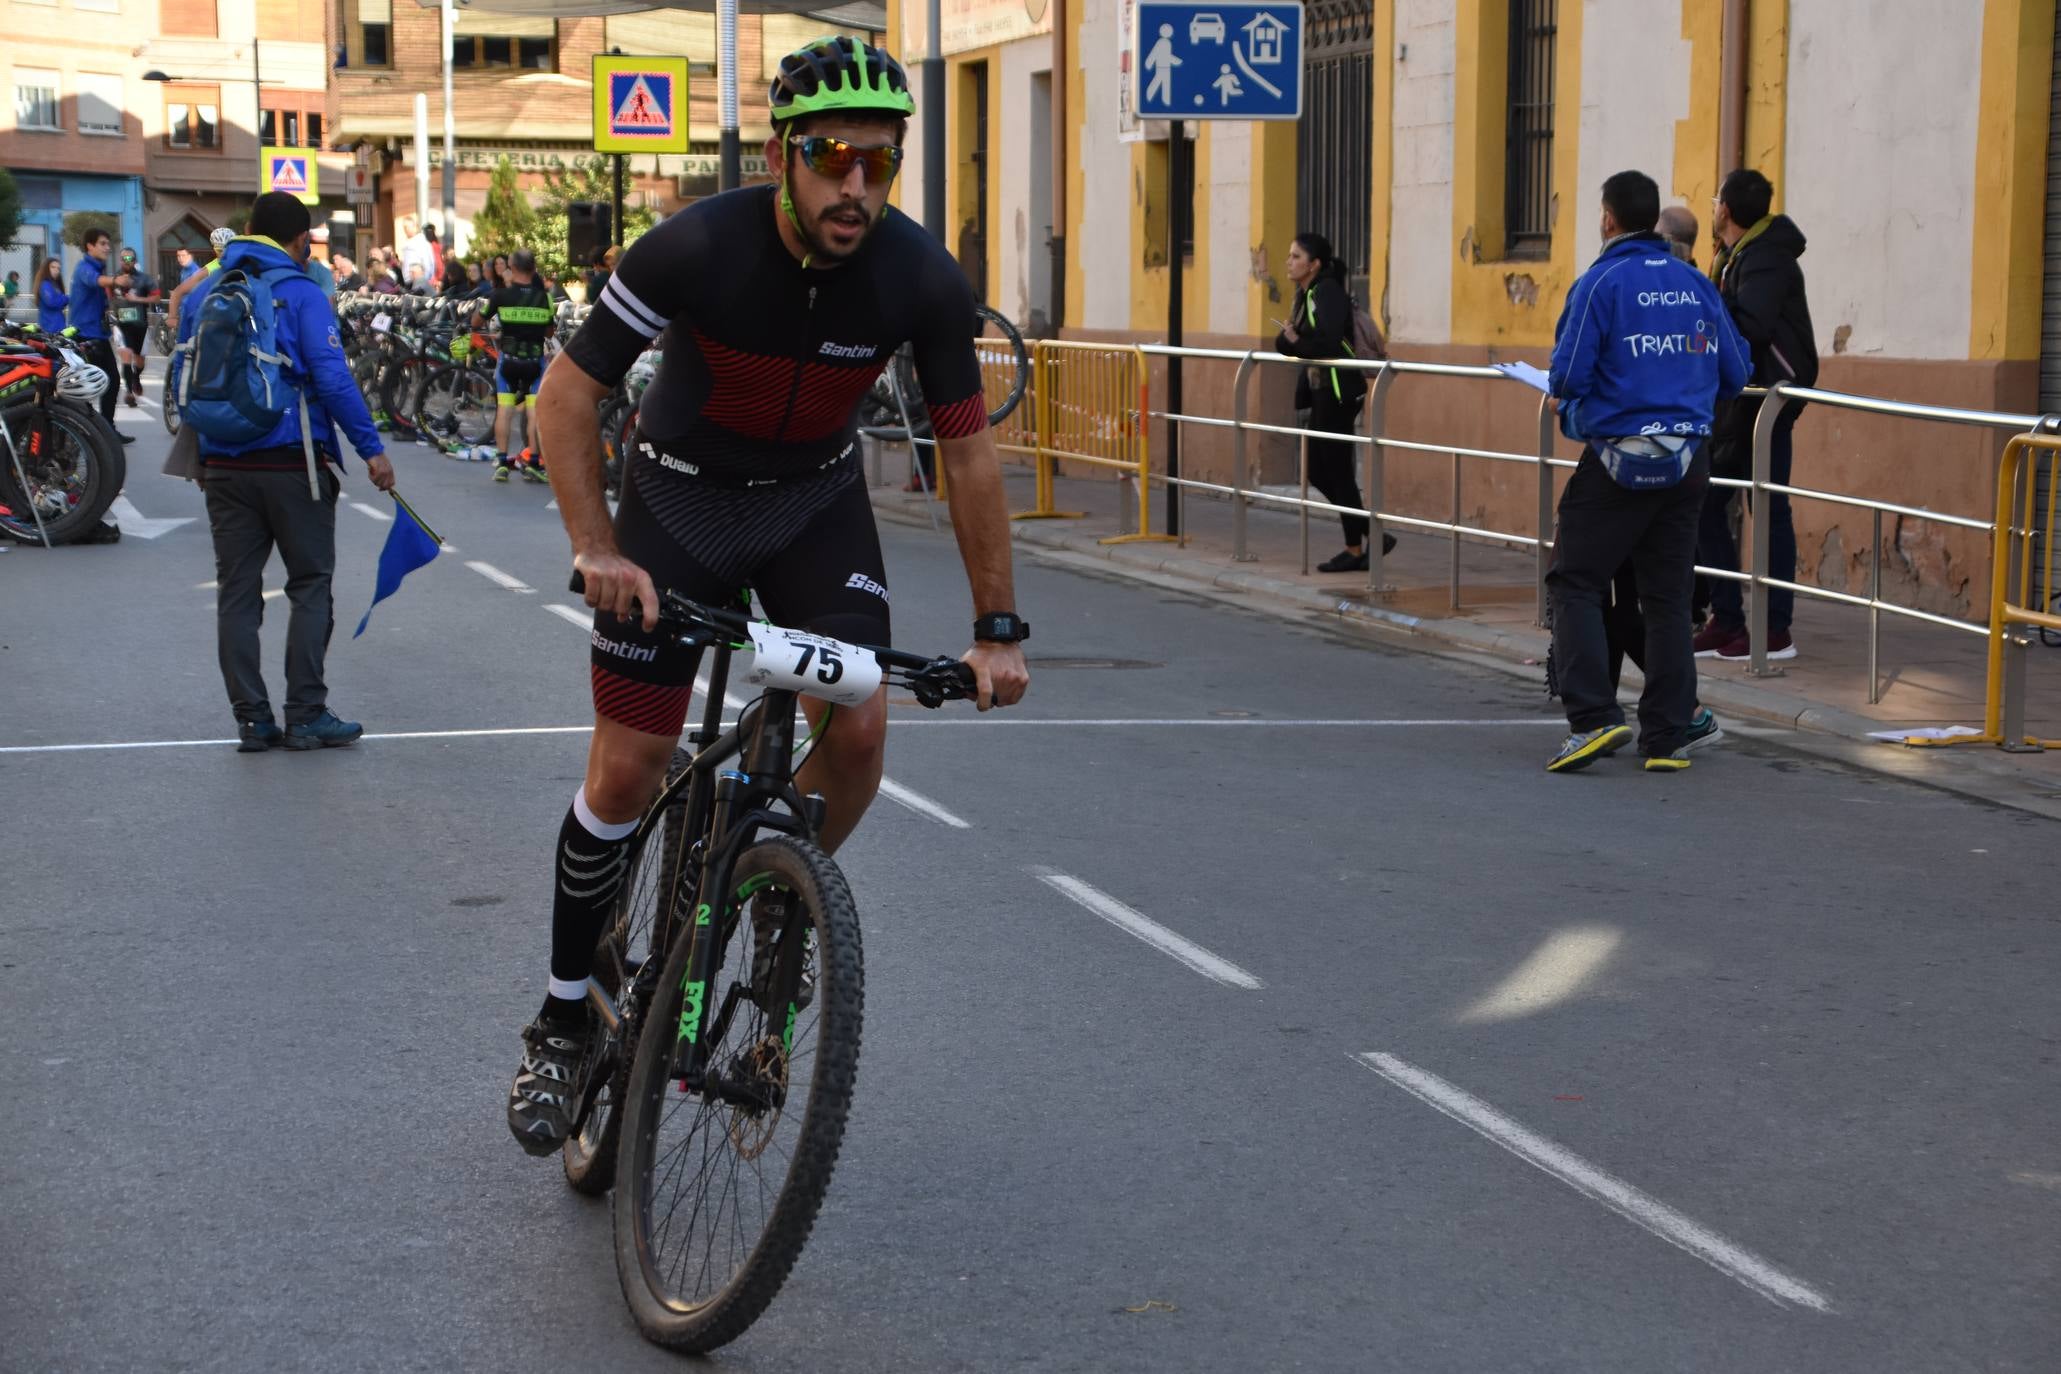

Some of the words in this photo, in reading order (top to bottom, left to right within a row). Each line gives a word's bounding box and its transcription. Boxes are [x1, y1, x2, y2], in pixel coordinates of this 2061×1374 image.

[428, 150, 564, 167] CFETERIA
[1637, 290, 1701, 307] OFICIAL
[818, 341, 878, 358] Santini
[591, 629, 659, 662] Santini
[789, 641, 844, 685] 75
[677, 980, 706, 1044] FOX
